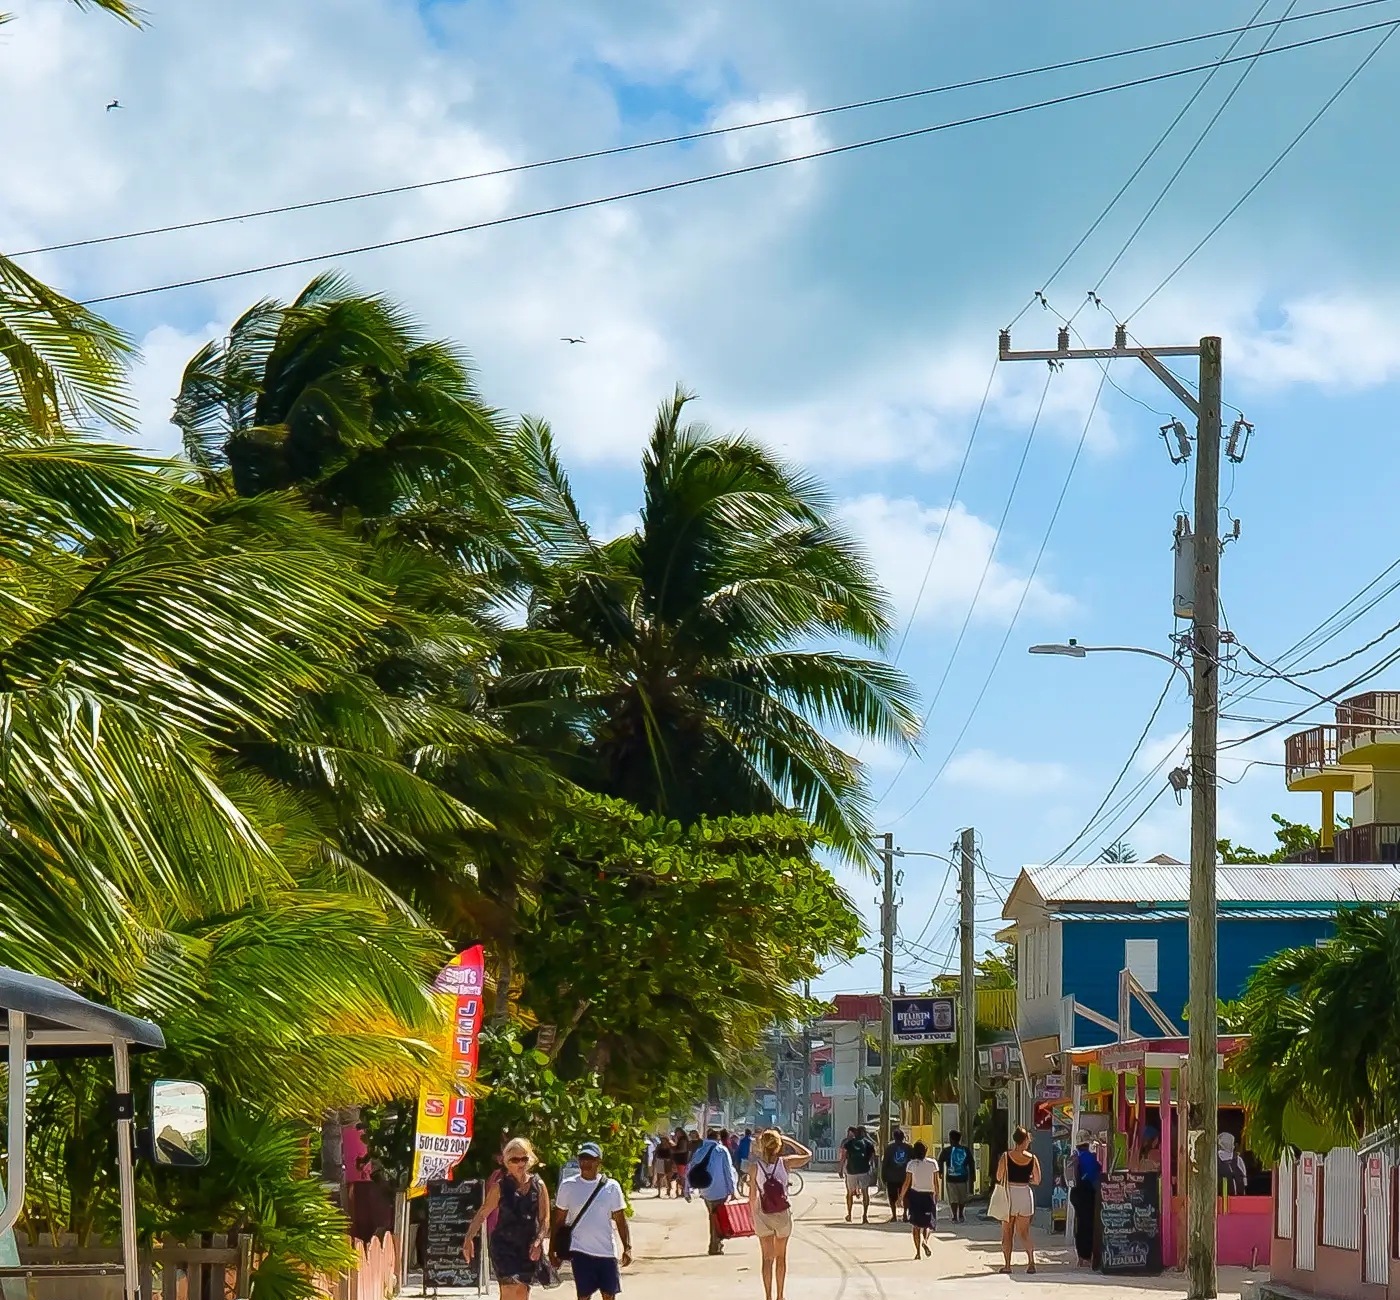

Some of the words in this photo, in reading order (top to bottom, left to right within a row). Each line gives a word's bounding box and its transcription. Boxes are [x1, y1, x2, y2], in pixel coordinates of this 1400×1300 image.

[456, 1000, 477, 1054] JET
[450, 1060, 473, 1135] SIS
[419, 1135, 433, 1150] 501
[434, 1137, 449, 1152] 629
